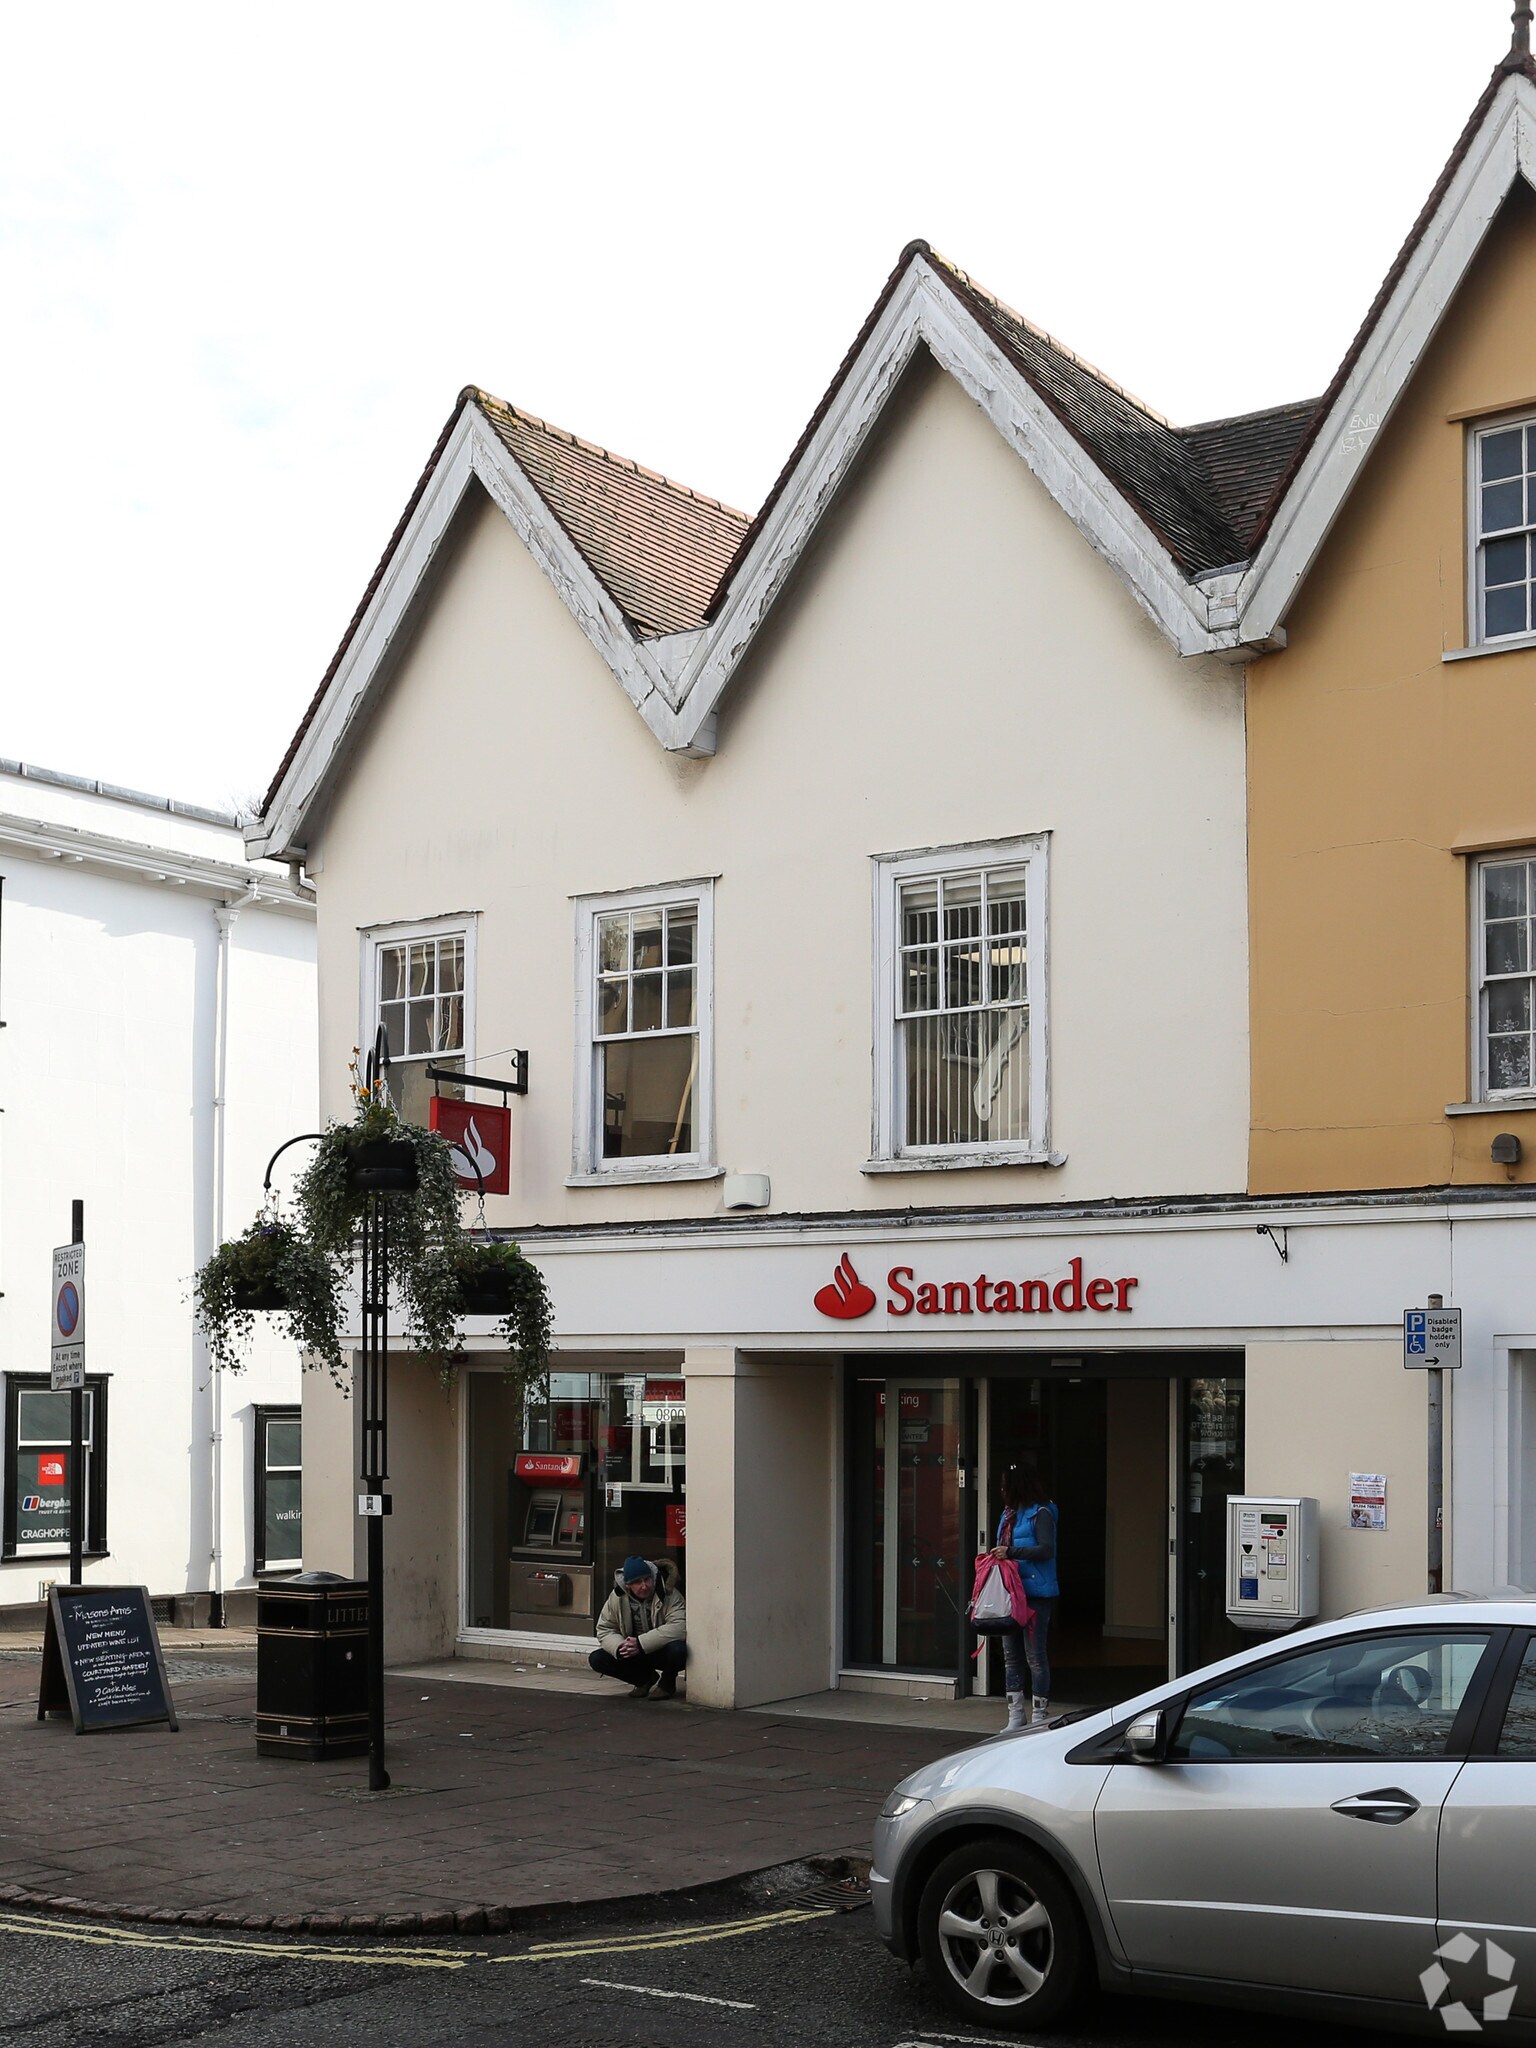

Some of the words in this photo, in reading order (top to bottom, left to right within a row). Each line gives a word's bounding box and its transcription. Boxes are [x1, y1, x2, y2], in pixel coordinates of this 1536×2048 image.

[54, 1249, 82, 1262] RESTRICTED
[58, 1260, 78, 1278] ZONE
[887, 1257, 1138, 1315] Santander
[1411, 1315, 1423, 1331] P
[880, 1393, 919, 1407] Bing
[656, 1408, 685, 1421] 0800
[21, 1528, 70, 1539] CRAGHOPPE
[75, 1609, 109, 1621] Masons
[110, 1605, 132, 1616] Arms
[86, 1631, 103, 1641] NEW
[104, 1630, 126, 1638] MENU
[77, 1640, 108, 1651] UPDATED
[109, 1638, 127, 1646] WINE
[82, 1667, 120, 1677] COURTYARD
[95, 1687, 101, 1697] 9
[102, 1686, 120, 1695] Cask
[121, 1684, 136, 1692] Ales
